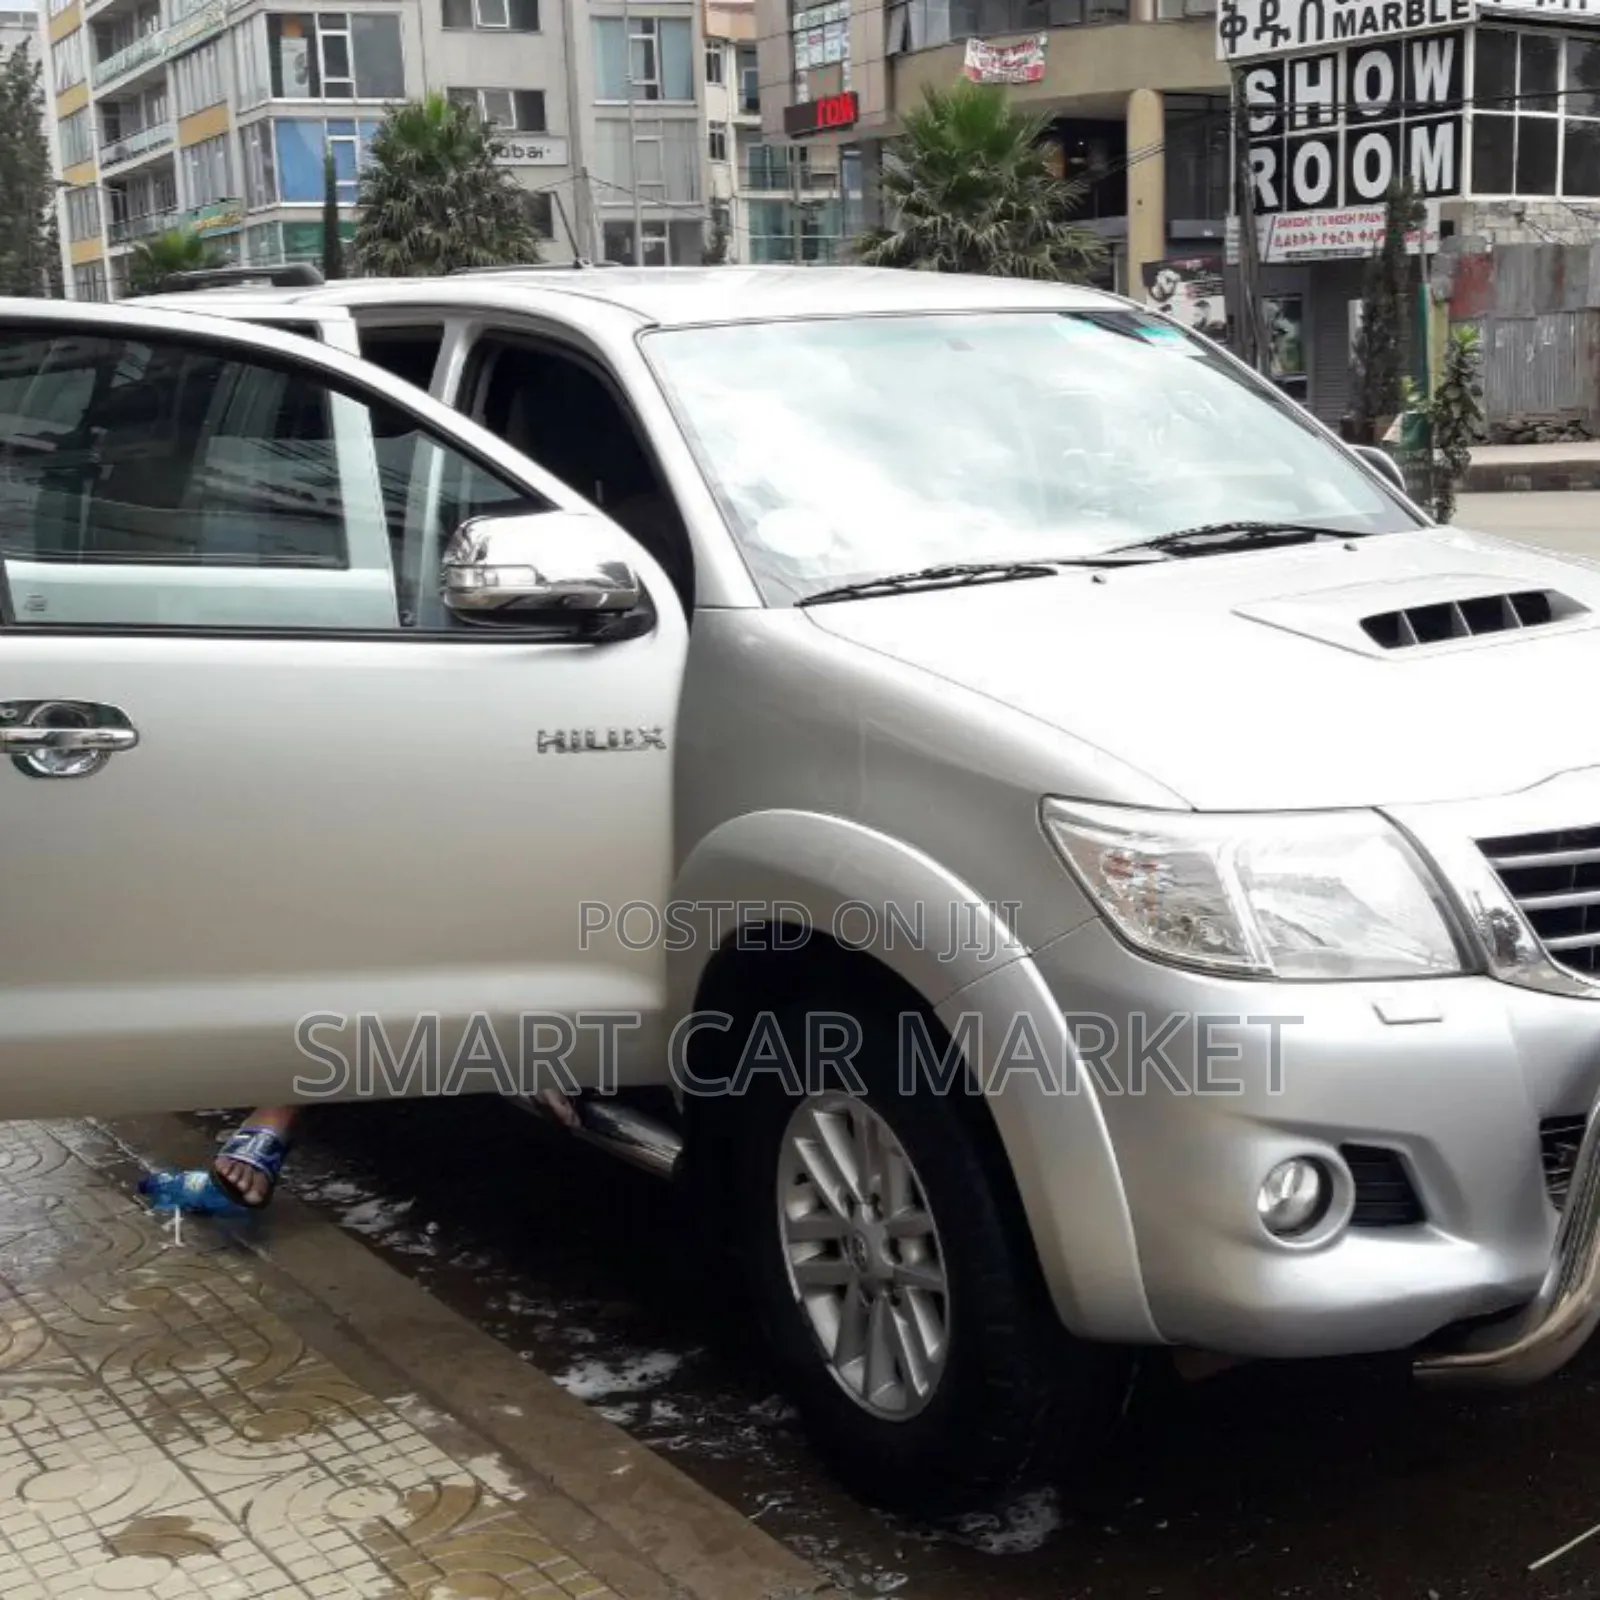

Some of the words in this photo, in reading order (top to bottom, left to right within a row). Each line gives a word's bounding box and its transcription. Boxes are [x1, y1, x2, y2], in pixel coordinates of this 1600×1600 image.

[1333, 0, 1469, 38] MARBLE
[1246, 38, 1455, 132] SHOW
[1249, 121, 1455, 207] ROOM
[537, 728, 667, 754] HILUX
